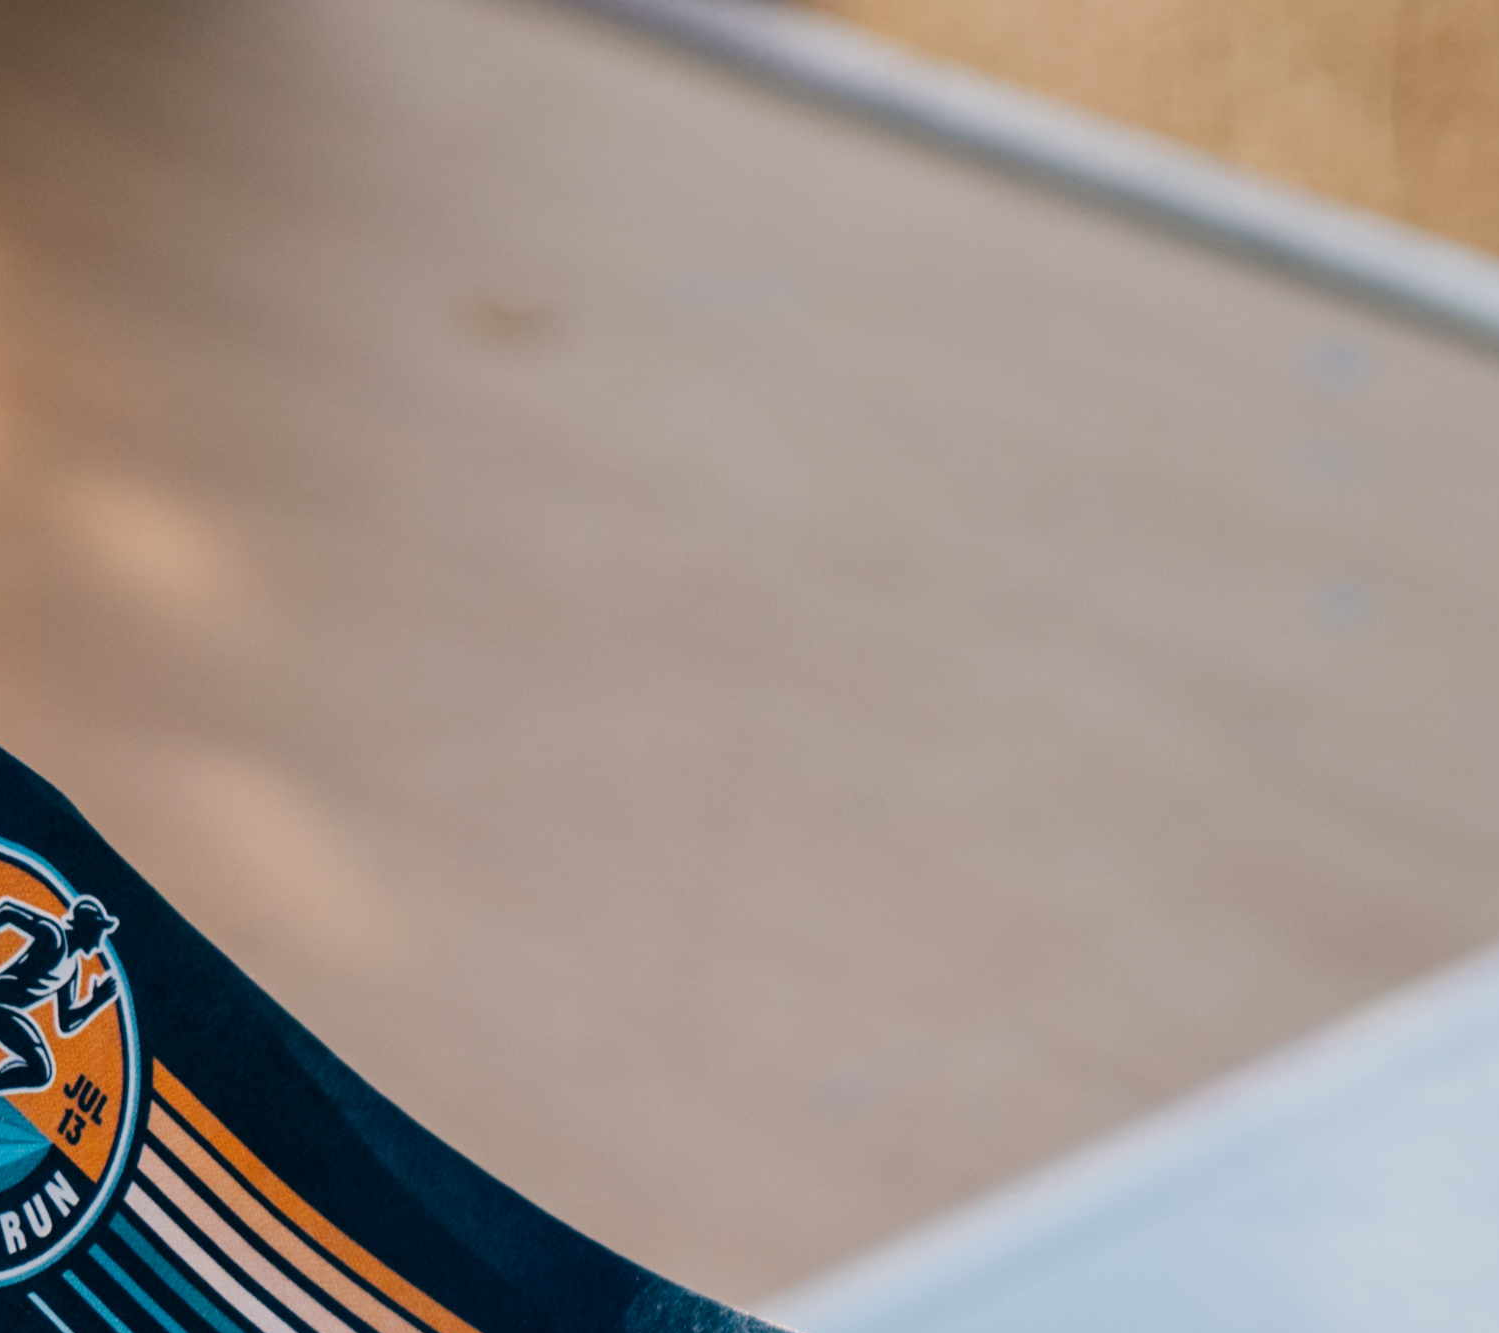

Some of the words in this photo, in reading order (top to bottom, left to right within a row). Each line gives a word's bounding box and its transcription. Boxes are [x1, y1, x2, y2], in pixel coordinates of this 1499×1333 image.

[62, 1073, 109, 1126] JUL
[56, 1107, 87, 1147] 13
[0, 1170, 81, 1255] RUN
